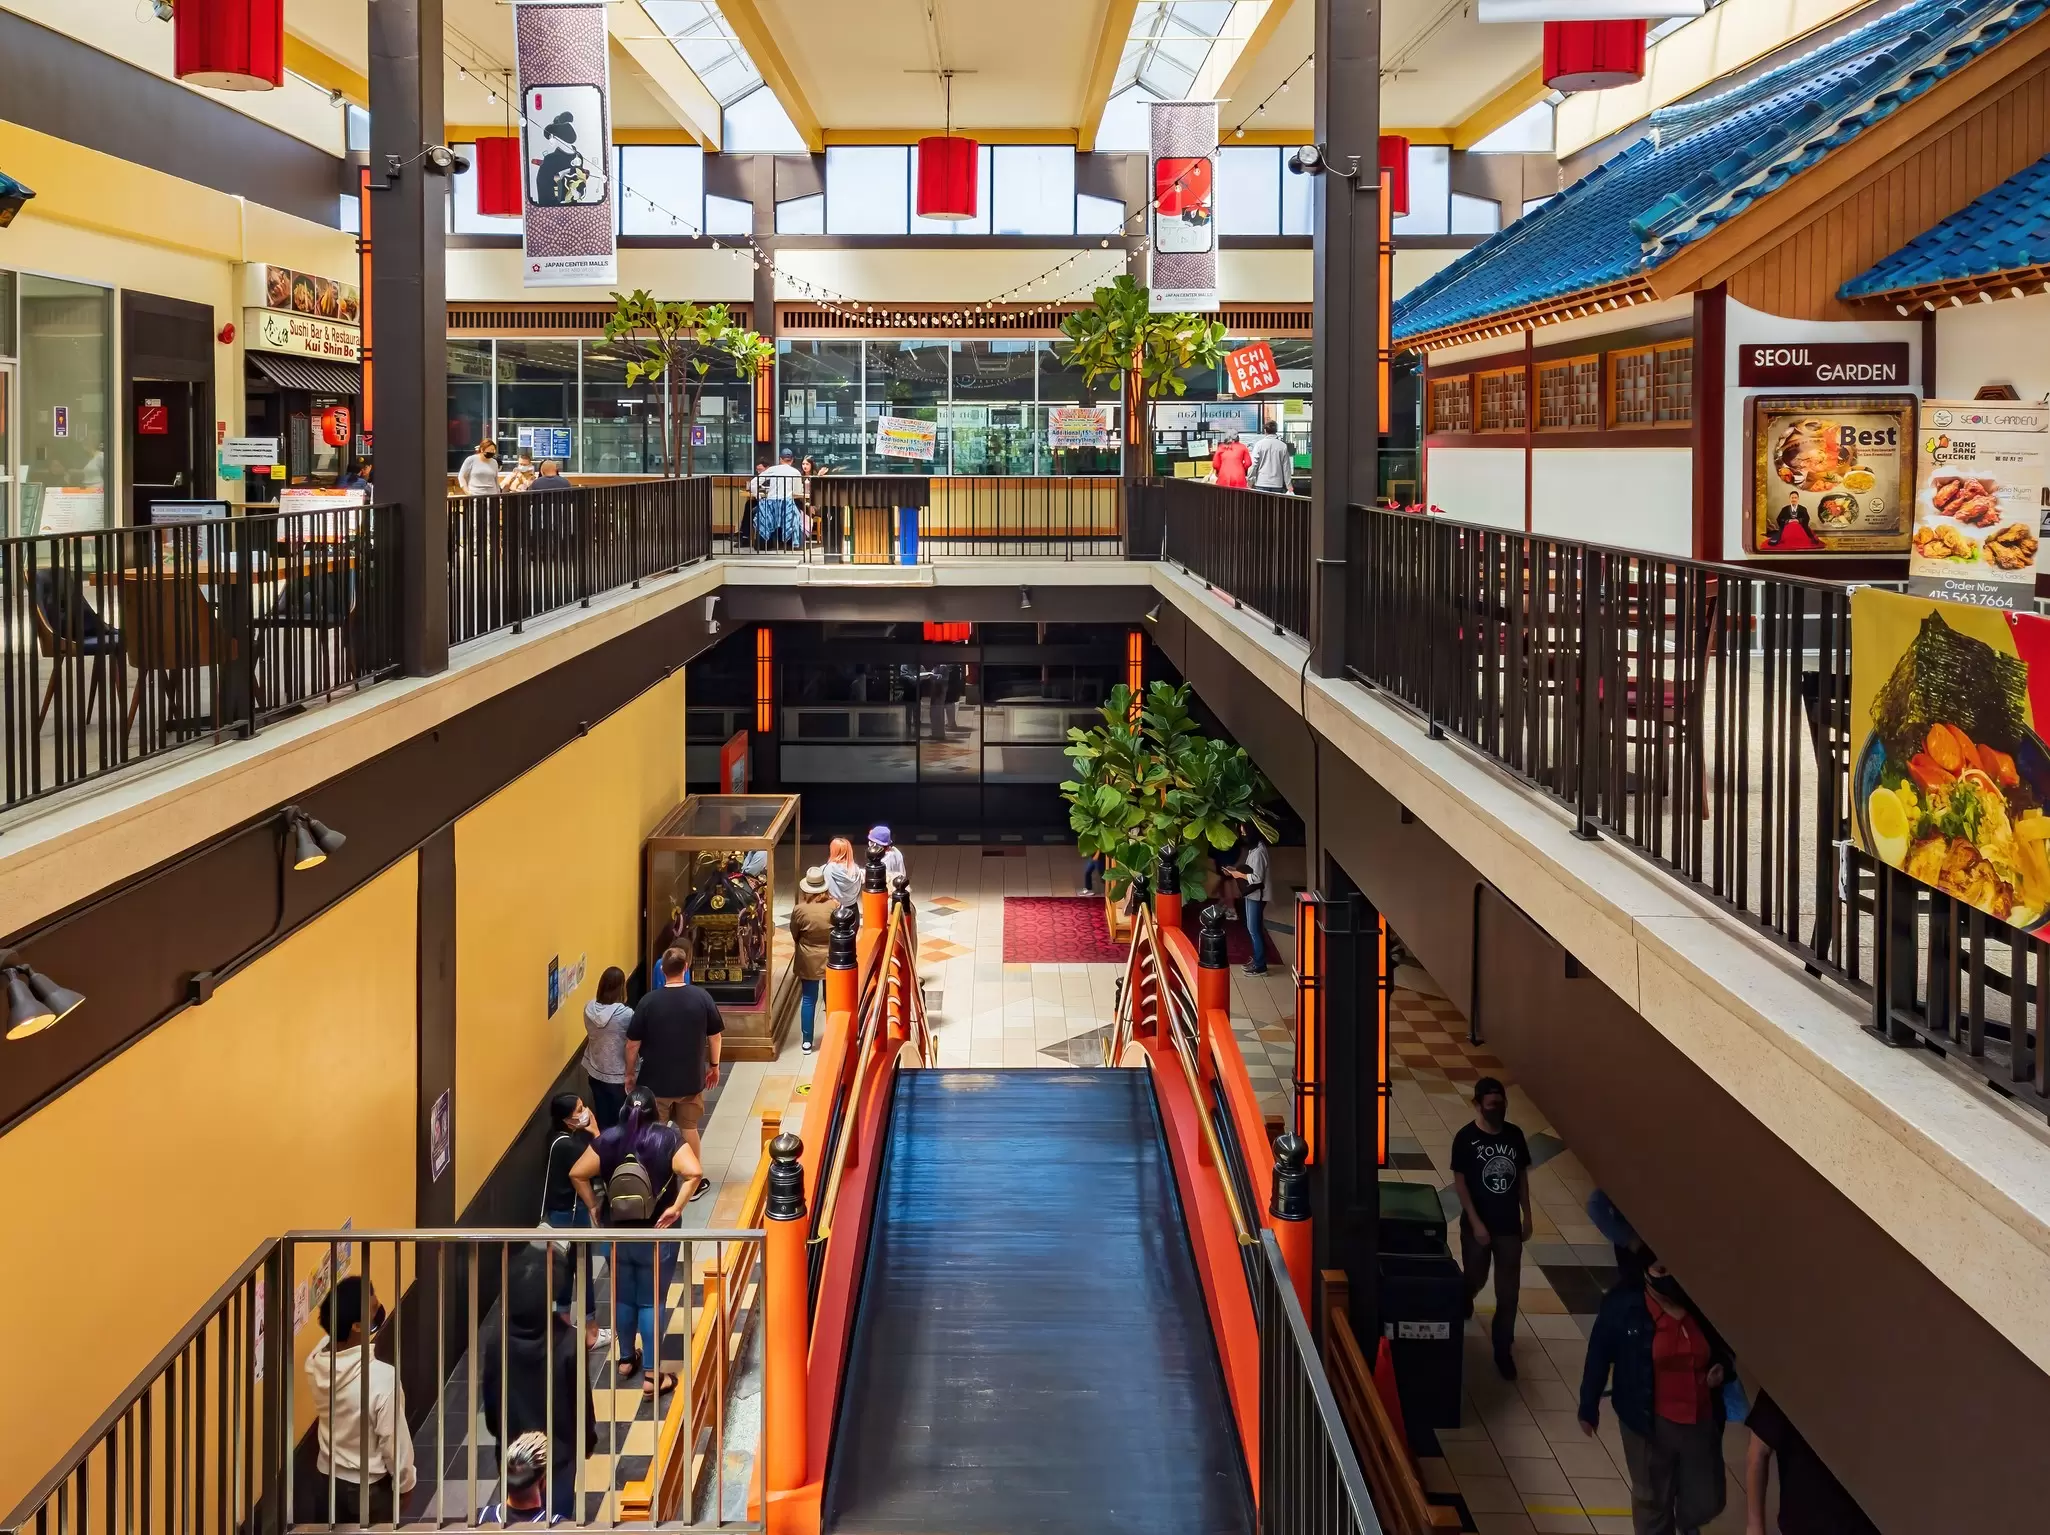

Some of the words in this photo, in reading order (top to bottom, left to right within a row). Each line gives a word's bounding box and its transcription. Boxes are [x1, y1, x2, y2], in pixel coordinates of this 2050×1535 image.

[289, 320, 308, 337] Sushi
[310, 324, 322, 340] Bar
[324, 326, 330, 340] &
[305, 339, 320, 352] Kui
[324, 341, 342, 355] Shin
[344, 346, 354, 357] Bo
[1234, 348, 1264, 368] ICHI
[1754, 349, 1812, 366] SEOUL
[1237, 360, 1269, 380] BAN
[1816, 364, 1896, 381] GARDEN
[1240, 372, 1274, 392] KAN
[1960, 415, 1991, 424] SEOUL
[1994, 416, 2038, 426] GARDEN
[1840, 426, 1897, 446] Best
[1944, 580, 1975, 590] Order
[1977, 583, 1999, 592] Now
[1477, 1144, 1516, 1161] TOWN
[1492, 1179, 1507, 1190] 30
